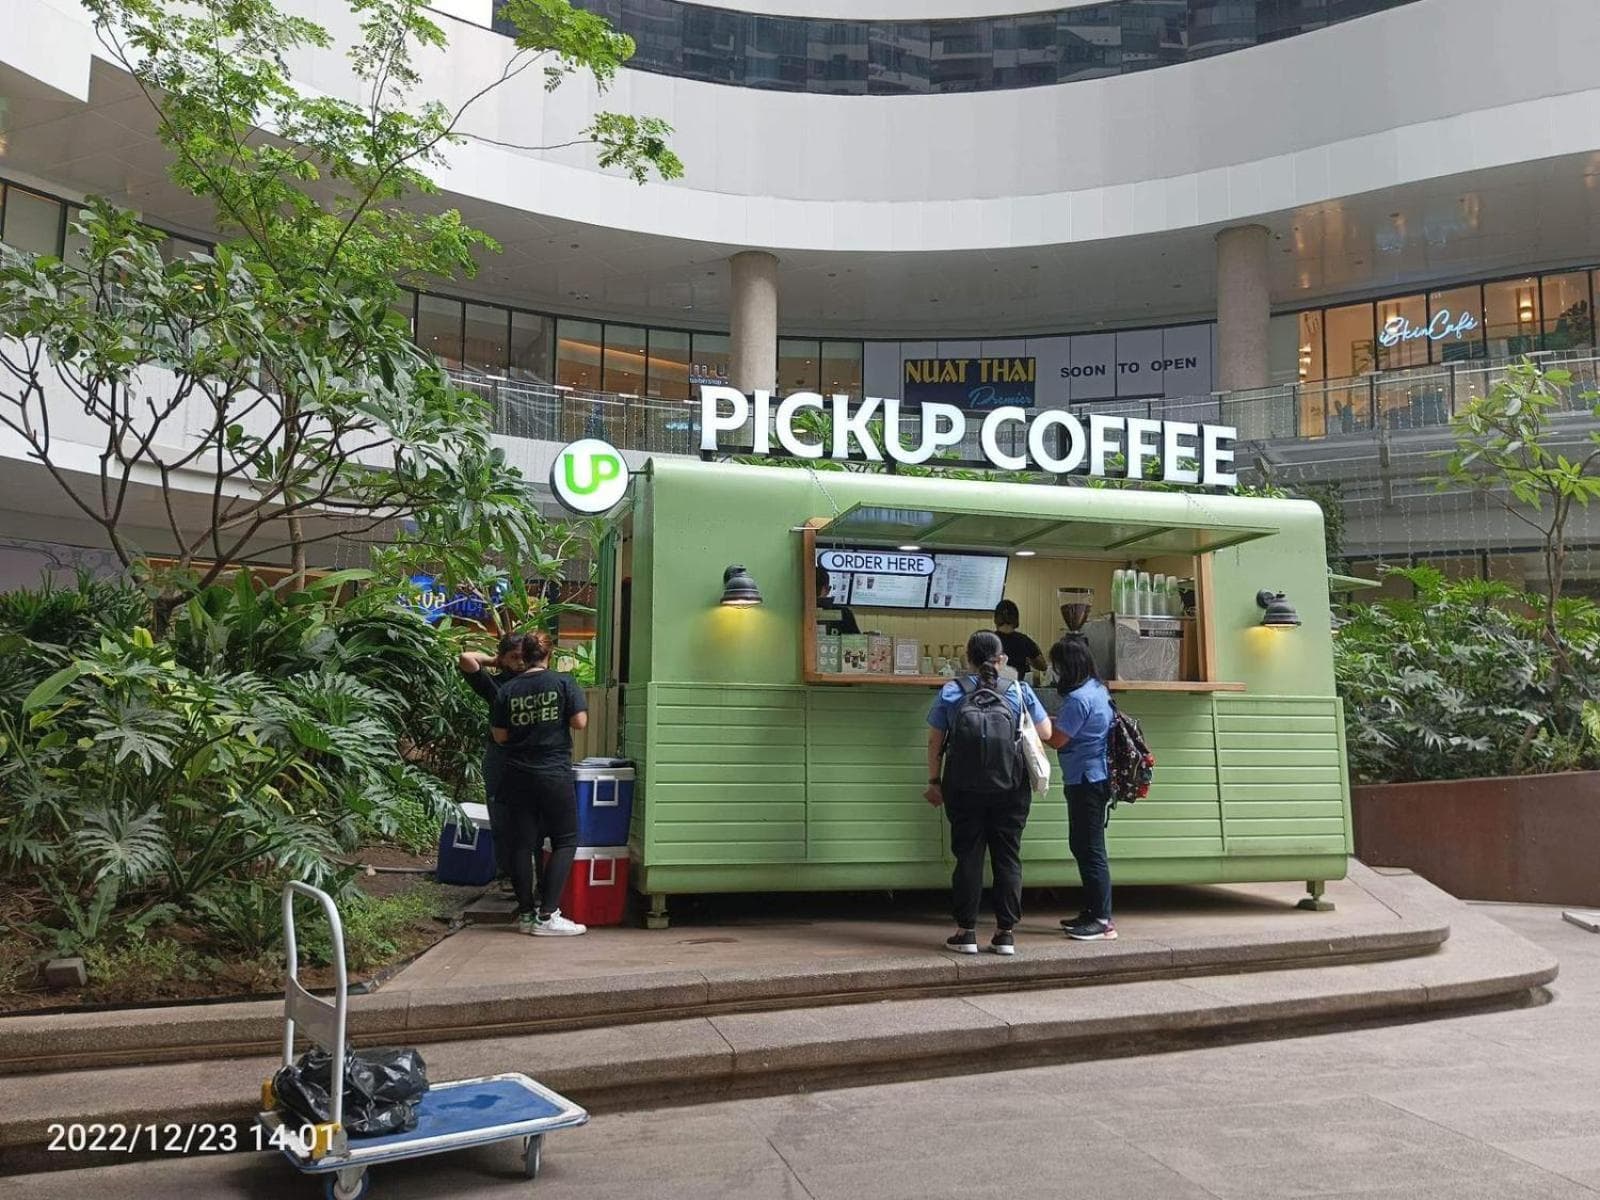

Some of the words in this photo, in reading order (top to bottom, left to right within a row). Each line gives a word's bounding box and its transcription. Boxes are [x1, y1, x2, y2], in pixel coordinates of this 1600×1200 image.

[905, 359, 968, 383] NUAT
[977, 357, 1035, 383] THAI
[1060, 364, 1106, 378] SOON
[1118, 362, 1140, 374] TO
[1151, 357, 1197, 372] OPEN
[701, 385, 966, 465] PICKUP
[980, 406, 1238, 486] COFFEE
[564, 454, 620, 495] UP
[831, 554, 882, 569] ORDER
[887, 556, 924, 572] HERE
[510, 691, 558, 711] PICKUP
[510, 706, 559, 726] COFFEE
